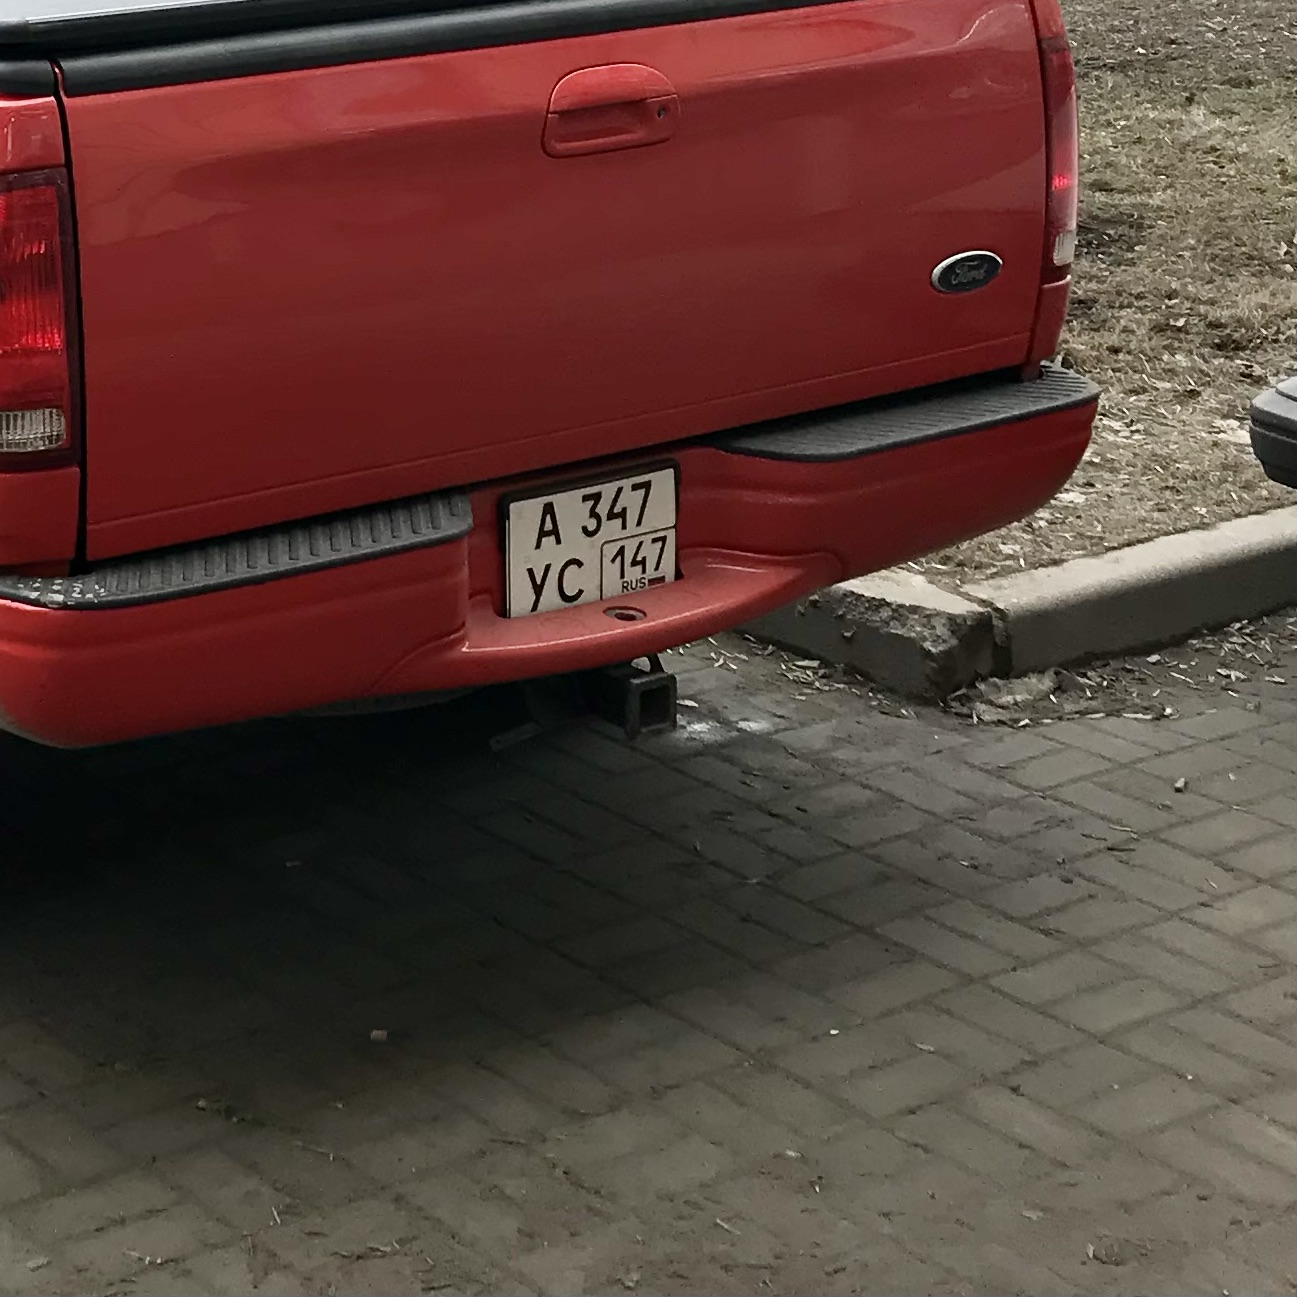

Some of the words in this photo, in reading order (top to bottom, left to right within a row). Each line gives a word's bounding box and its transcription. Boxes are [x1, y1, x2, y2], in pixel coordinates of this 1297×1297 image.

[581, 480, 652, 538] 347
[610, 535, 668, 580] 147
[526, 558, 585, 613] УС
[621, 577, 647, 593] RUS
